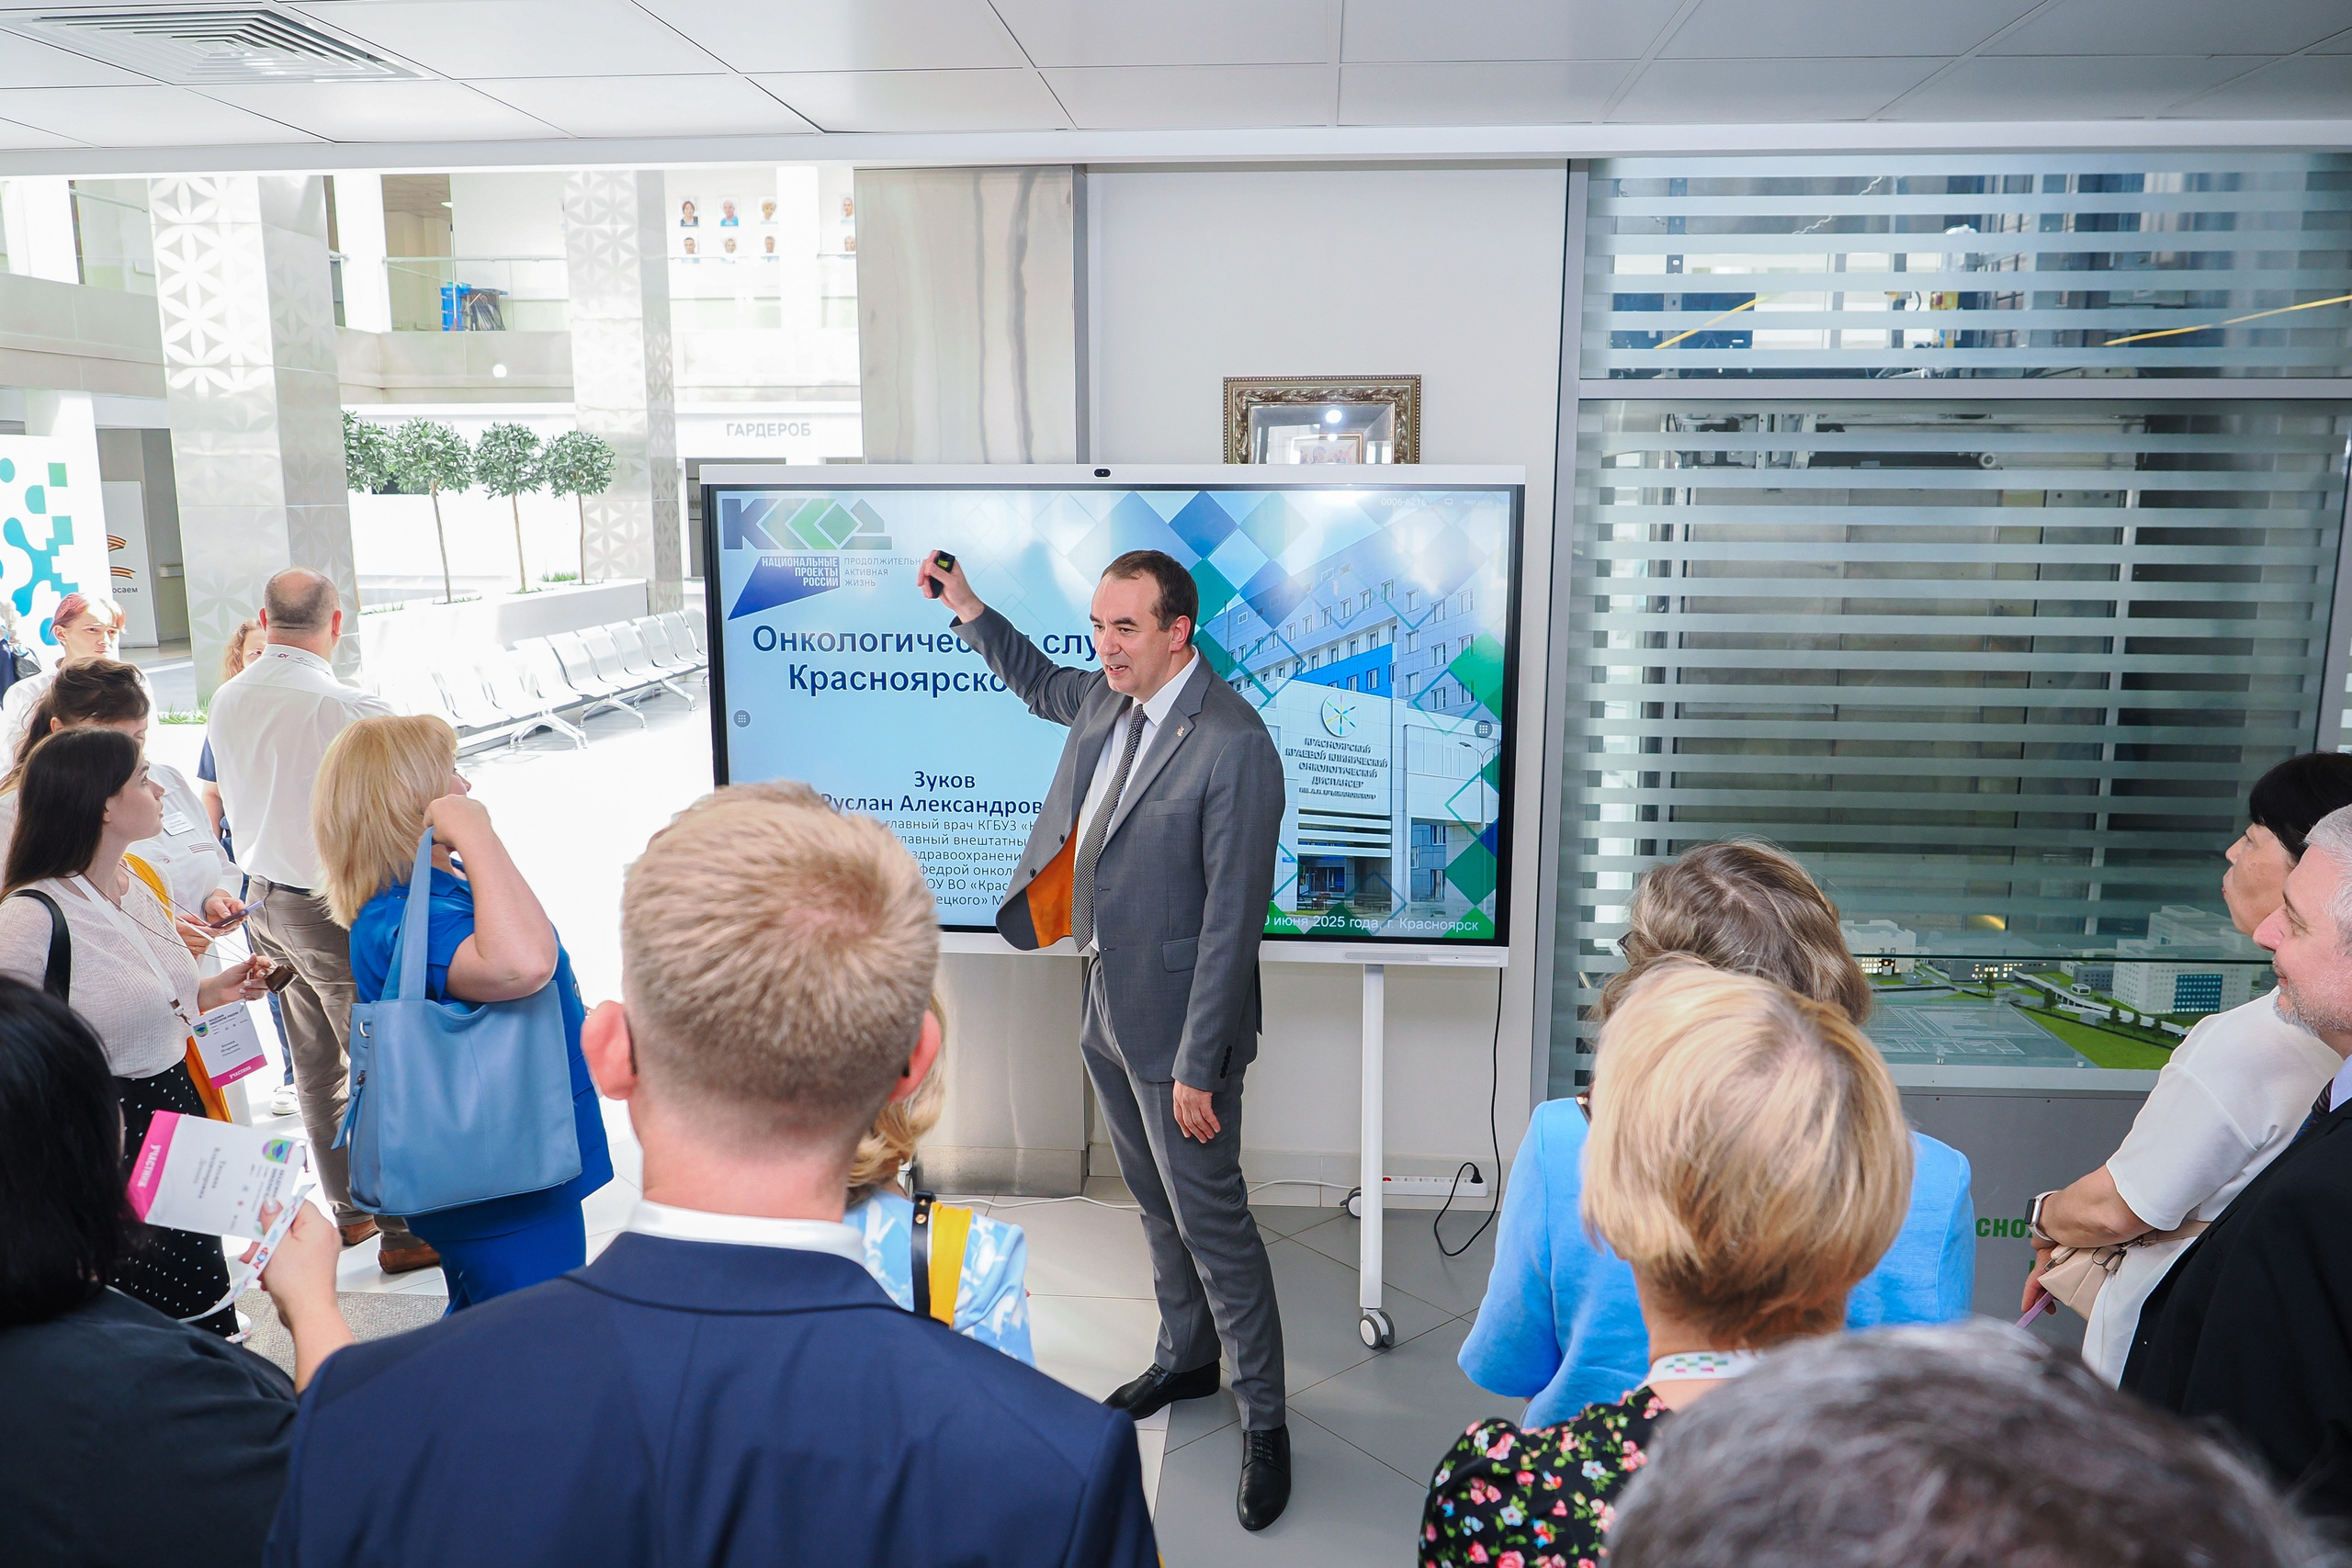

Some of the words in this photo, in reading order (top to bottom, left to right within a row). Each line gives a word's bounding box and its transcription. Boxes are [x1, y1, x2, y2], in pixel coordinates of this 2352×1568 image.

[726, 423, 811, 439] ГАРДЕРОБ
[762, 557, 838, 568] НАЦИОНАЛЬНЫЕ
[844, 558, 926, 566] ПРОДОЛЖИТЕЛЬН
[795, 568, 838, 577] ПРОЕКТЫ
[803, 577, 839, 587] РОССИИ
[752, 625, 1030, 653] Онкологичес
[1043, 634, 1096, 661] слу
[789, 663, 1007, 698] Красноярско
[1305, 737, 1372, 753] КРАСНОЯРСКИЙ
[1286, 748, 1327, 760] КРАЕВОЙ
[1329, 753, 1388, 768] КЛИНИЧЕСКИЙ
[1298, 761, 1378, 778] ОНКОЛОГИЧЕСКИЙ
[914, 771, 976, 791] Зуков
[1311, 775, 1364, 788] ДИСПАНСЕР
[820, 793, 893, 813] Руслан
[899, 795, 1043, 817] Александров
[886, 818, 939, 829] главный
[944, 820, 973, 834] врач
[978, 820, 1017, 831] КГБУЗ
[954, 836, 1027, 847] внештатны
[911, 851, 1022, 863] здравоохранени
[919, 863, 969, 877] федрой
[926, 878, 944, 891] ОУ
[948, 879, 966, 890] ВО
[970, 880, 1011, 894] «Крас
[933, 895, 988, 907] ецкого»
[1273, 917, 1308, 927] июня
[1313, 915, 1345, 928] 2025
[1350, 919, 1382, 931] года,
[1387, 920, 1394, 929] г.
[1399, 919, 1478, 932] Красноярск
[137, 1144, 162, 1189] УЧАСТНИК
[1975, 1217, 2032, 1239] СНО
